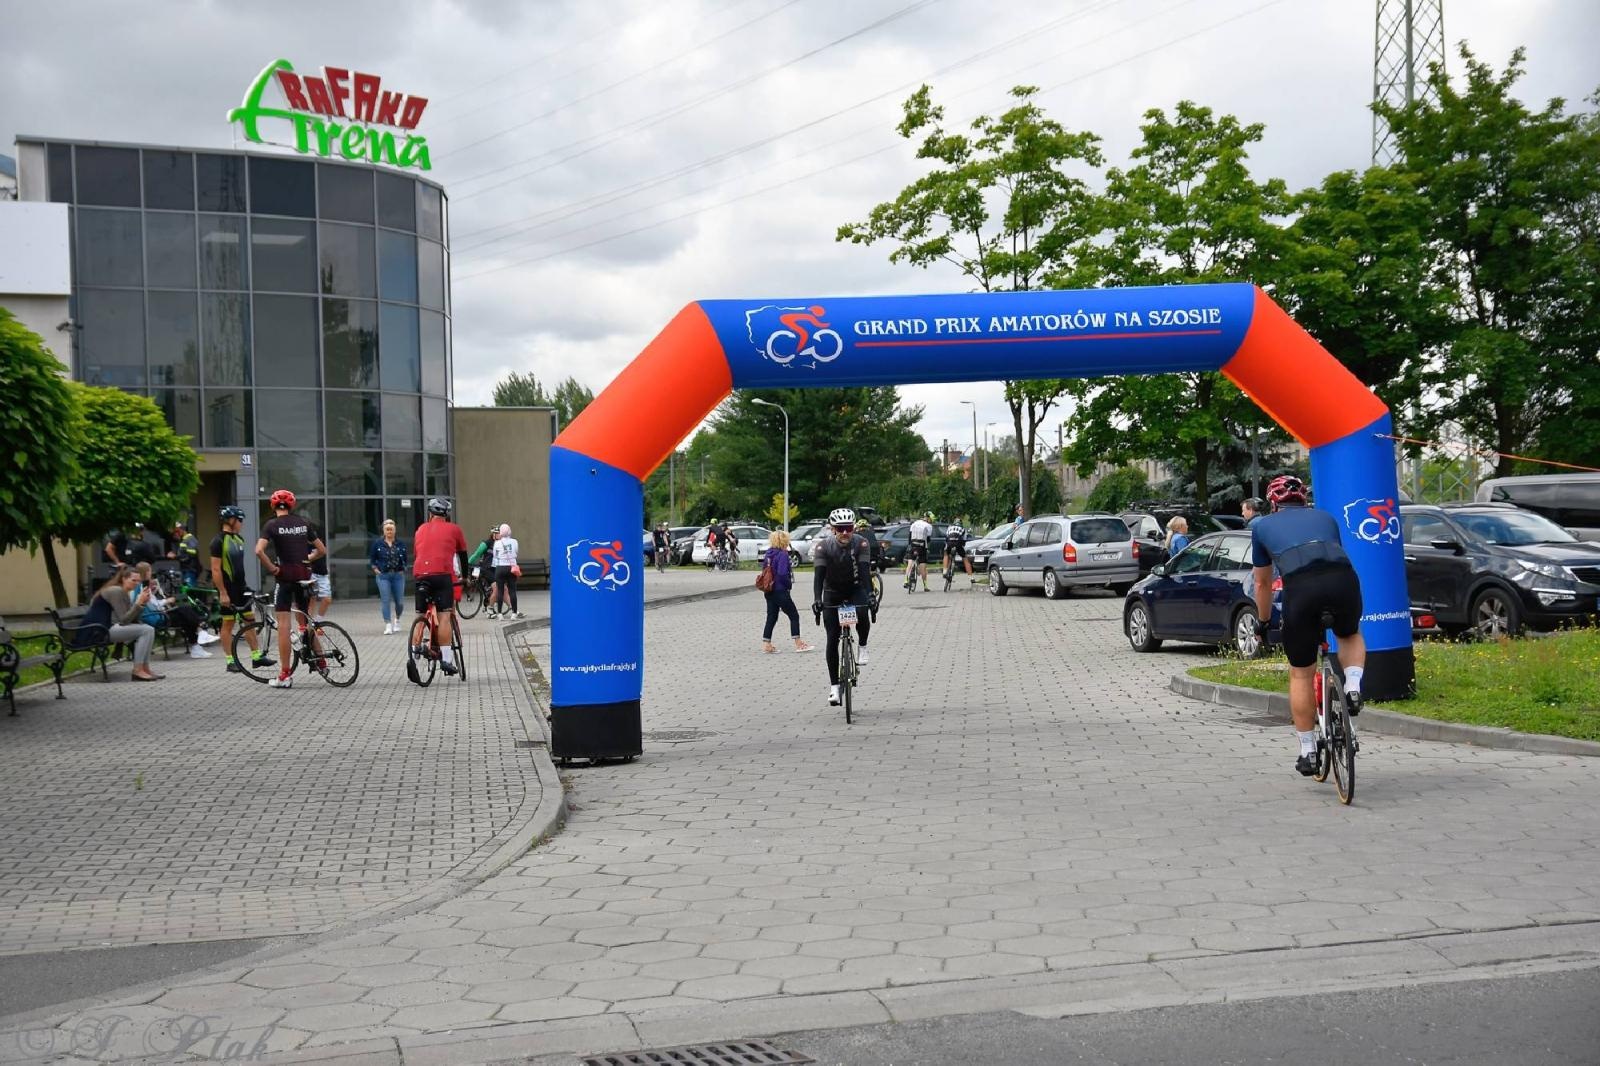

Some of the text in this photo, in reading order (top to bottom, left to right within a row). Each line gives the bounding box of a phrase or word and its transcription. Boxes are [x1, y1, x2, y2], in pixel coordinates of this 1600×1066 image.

[273, 65, 429, 130] RAFAKO
[226, 58, 432, 171] Arena
[853, 308, 1222, 336] GRAND PRIX AMATORÓW NA SZOSIE
[242, 454, 252, 465] 31
[559, 662, 637, 674] www.rajdydlafrajdy.pl
